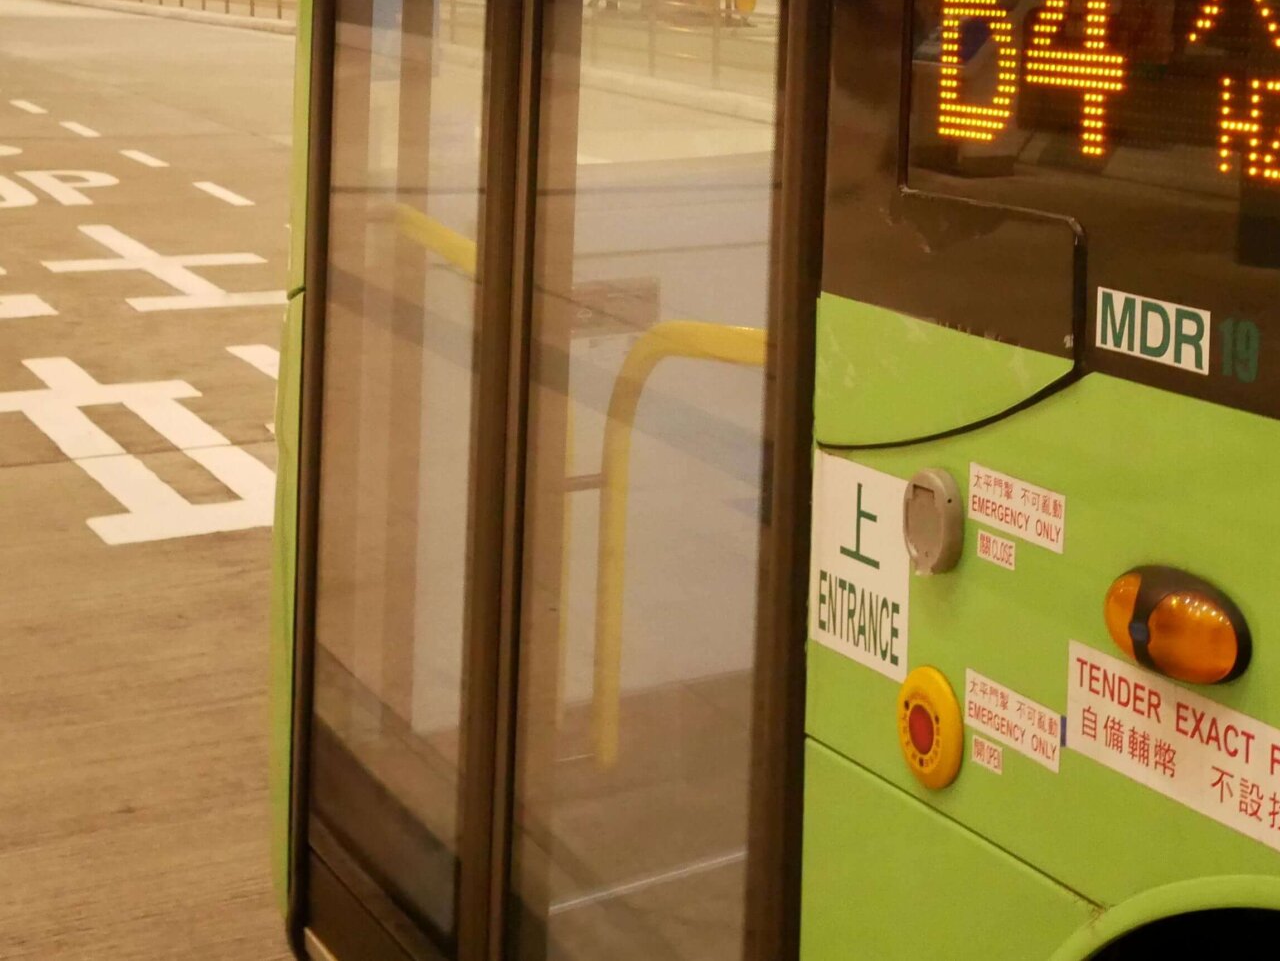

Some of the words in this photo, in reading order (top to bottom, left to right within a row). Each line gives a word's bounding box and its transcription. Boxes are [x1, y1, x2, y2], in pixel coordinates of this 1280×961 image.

[1101, 291, 1204, 371] MDR
[1218, 316, 1261, 384] 19
[840, 482, 880, 570] 上
[971, 494, 1031, 532] EMERGENCY
[1035, 518, 1061, 544] ONLY
[818, 569, 901, 667] ENTRANCE
[967, 700, 1026, 744] EMERGENCY
[1031, 734, 1057, 762] ONLY
[1076, 657, 1162, 724] TENDER
[1175, 701, 1256, 765] EXACT
[1081, 705, 1177, 779] 自備輔幣
